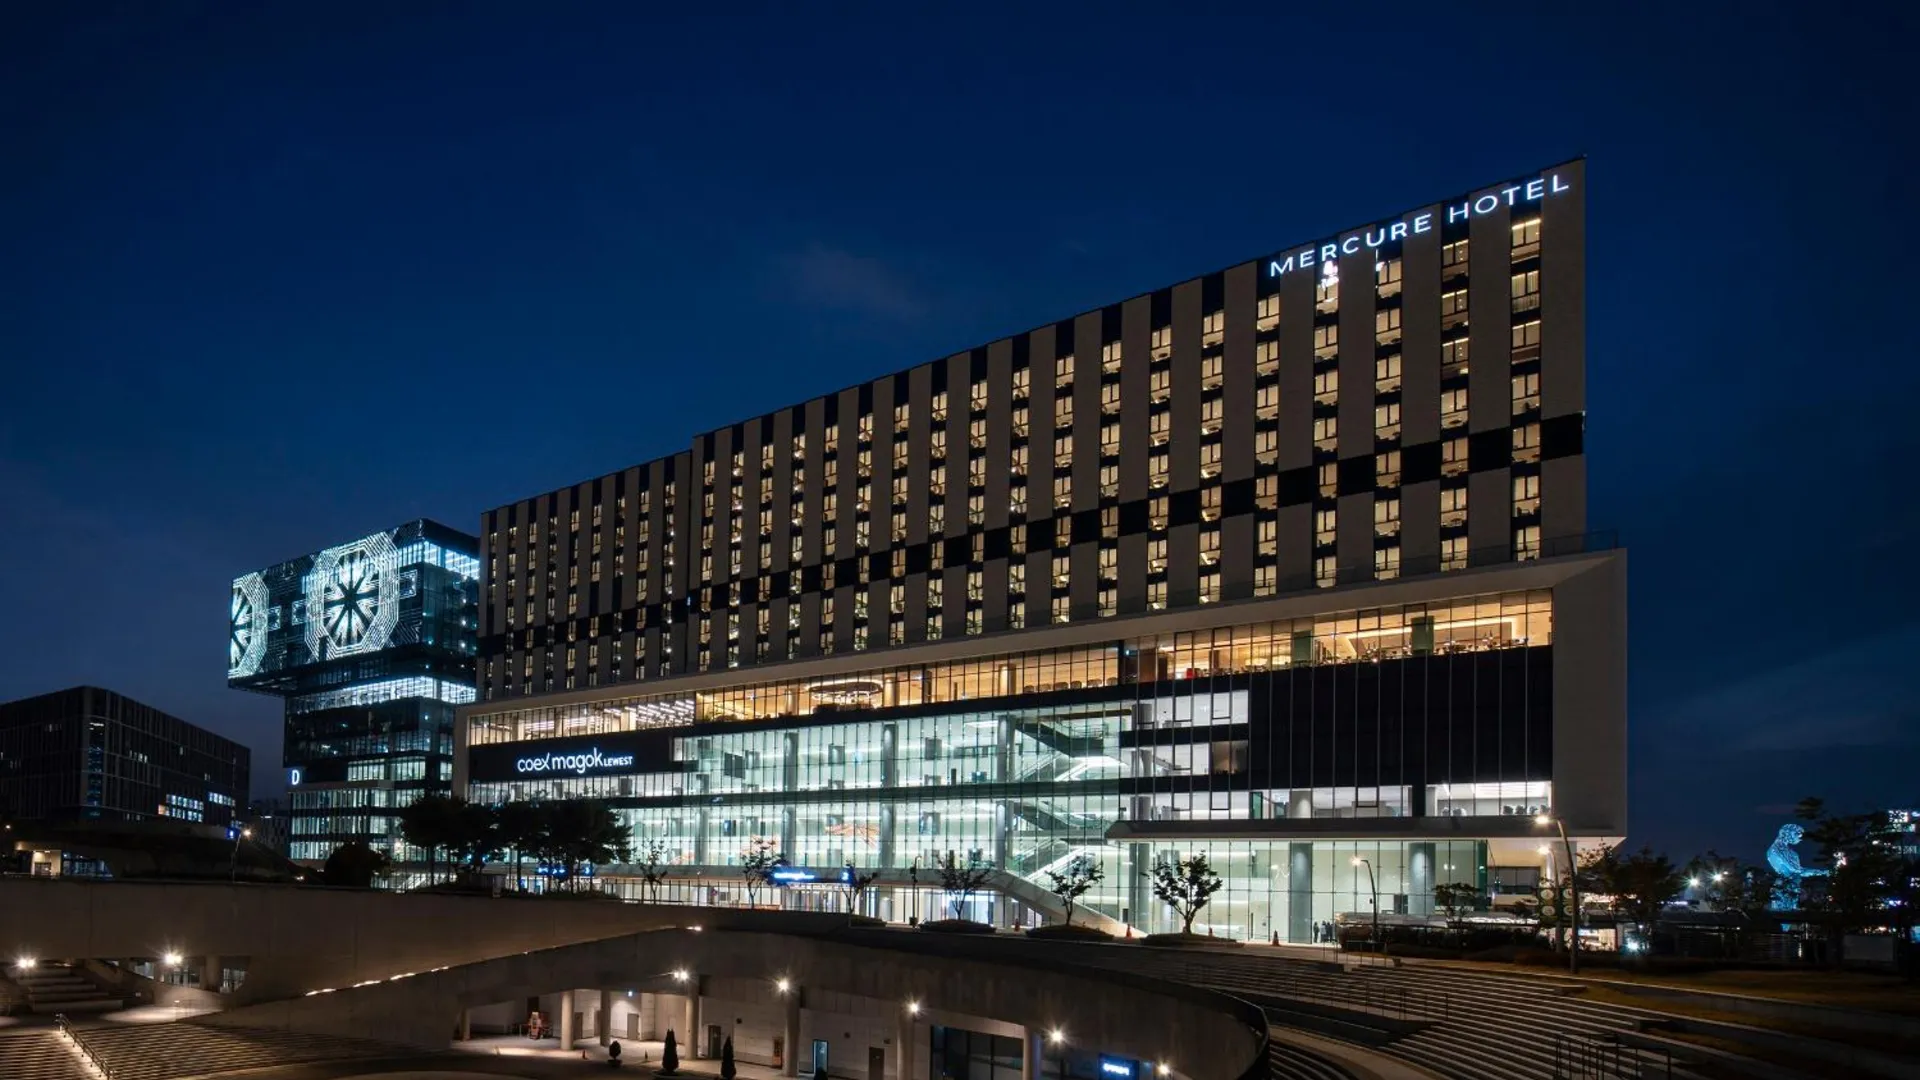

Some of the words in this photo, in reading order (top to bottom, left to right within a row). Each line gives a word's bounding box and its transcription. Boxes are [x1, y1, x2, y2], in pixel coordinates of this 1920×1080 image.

[1270, 213, 1432, 277] MERCURE
[1449, 174, 1570, 224] HOTEL
[552, 747, 603, 774] magok
[603, 756, 633, 767] LEWEST
[291, 769, 300, 786] D
